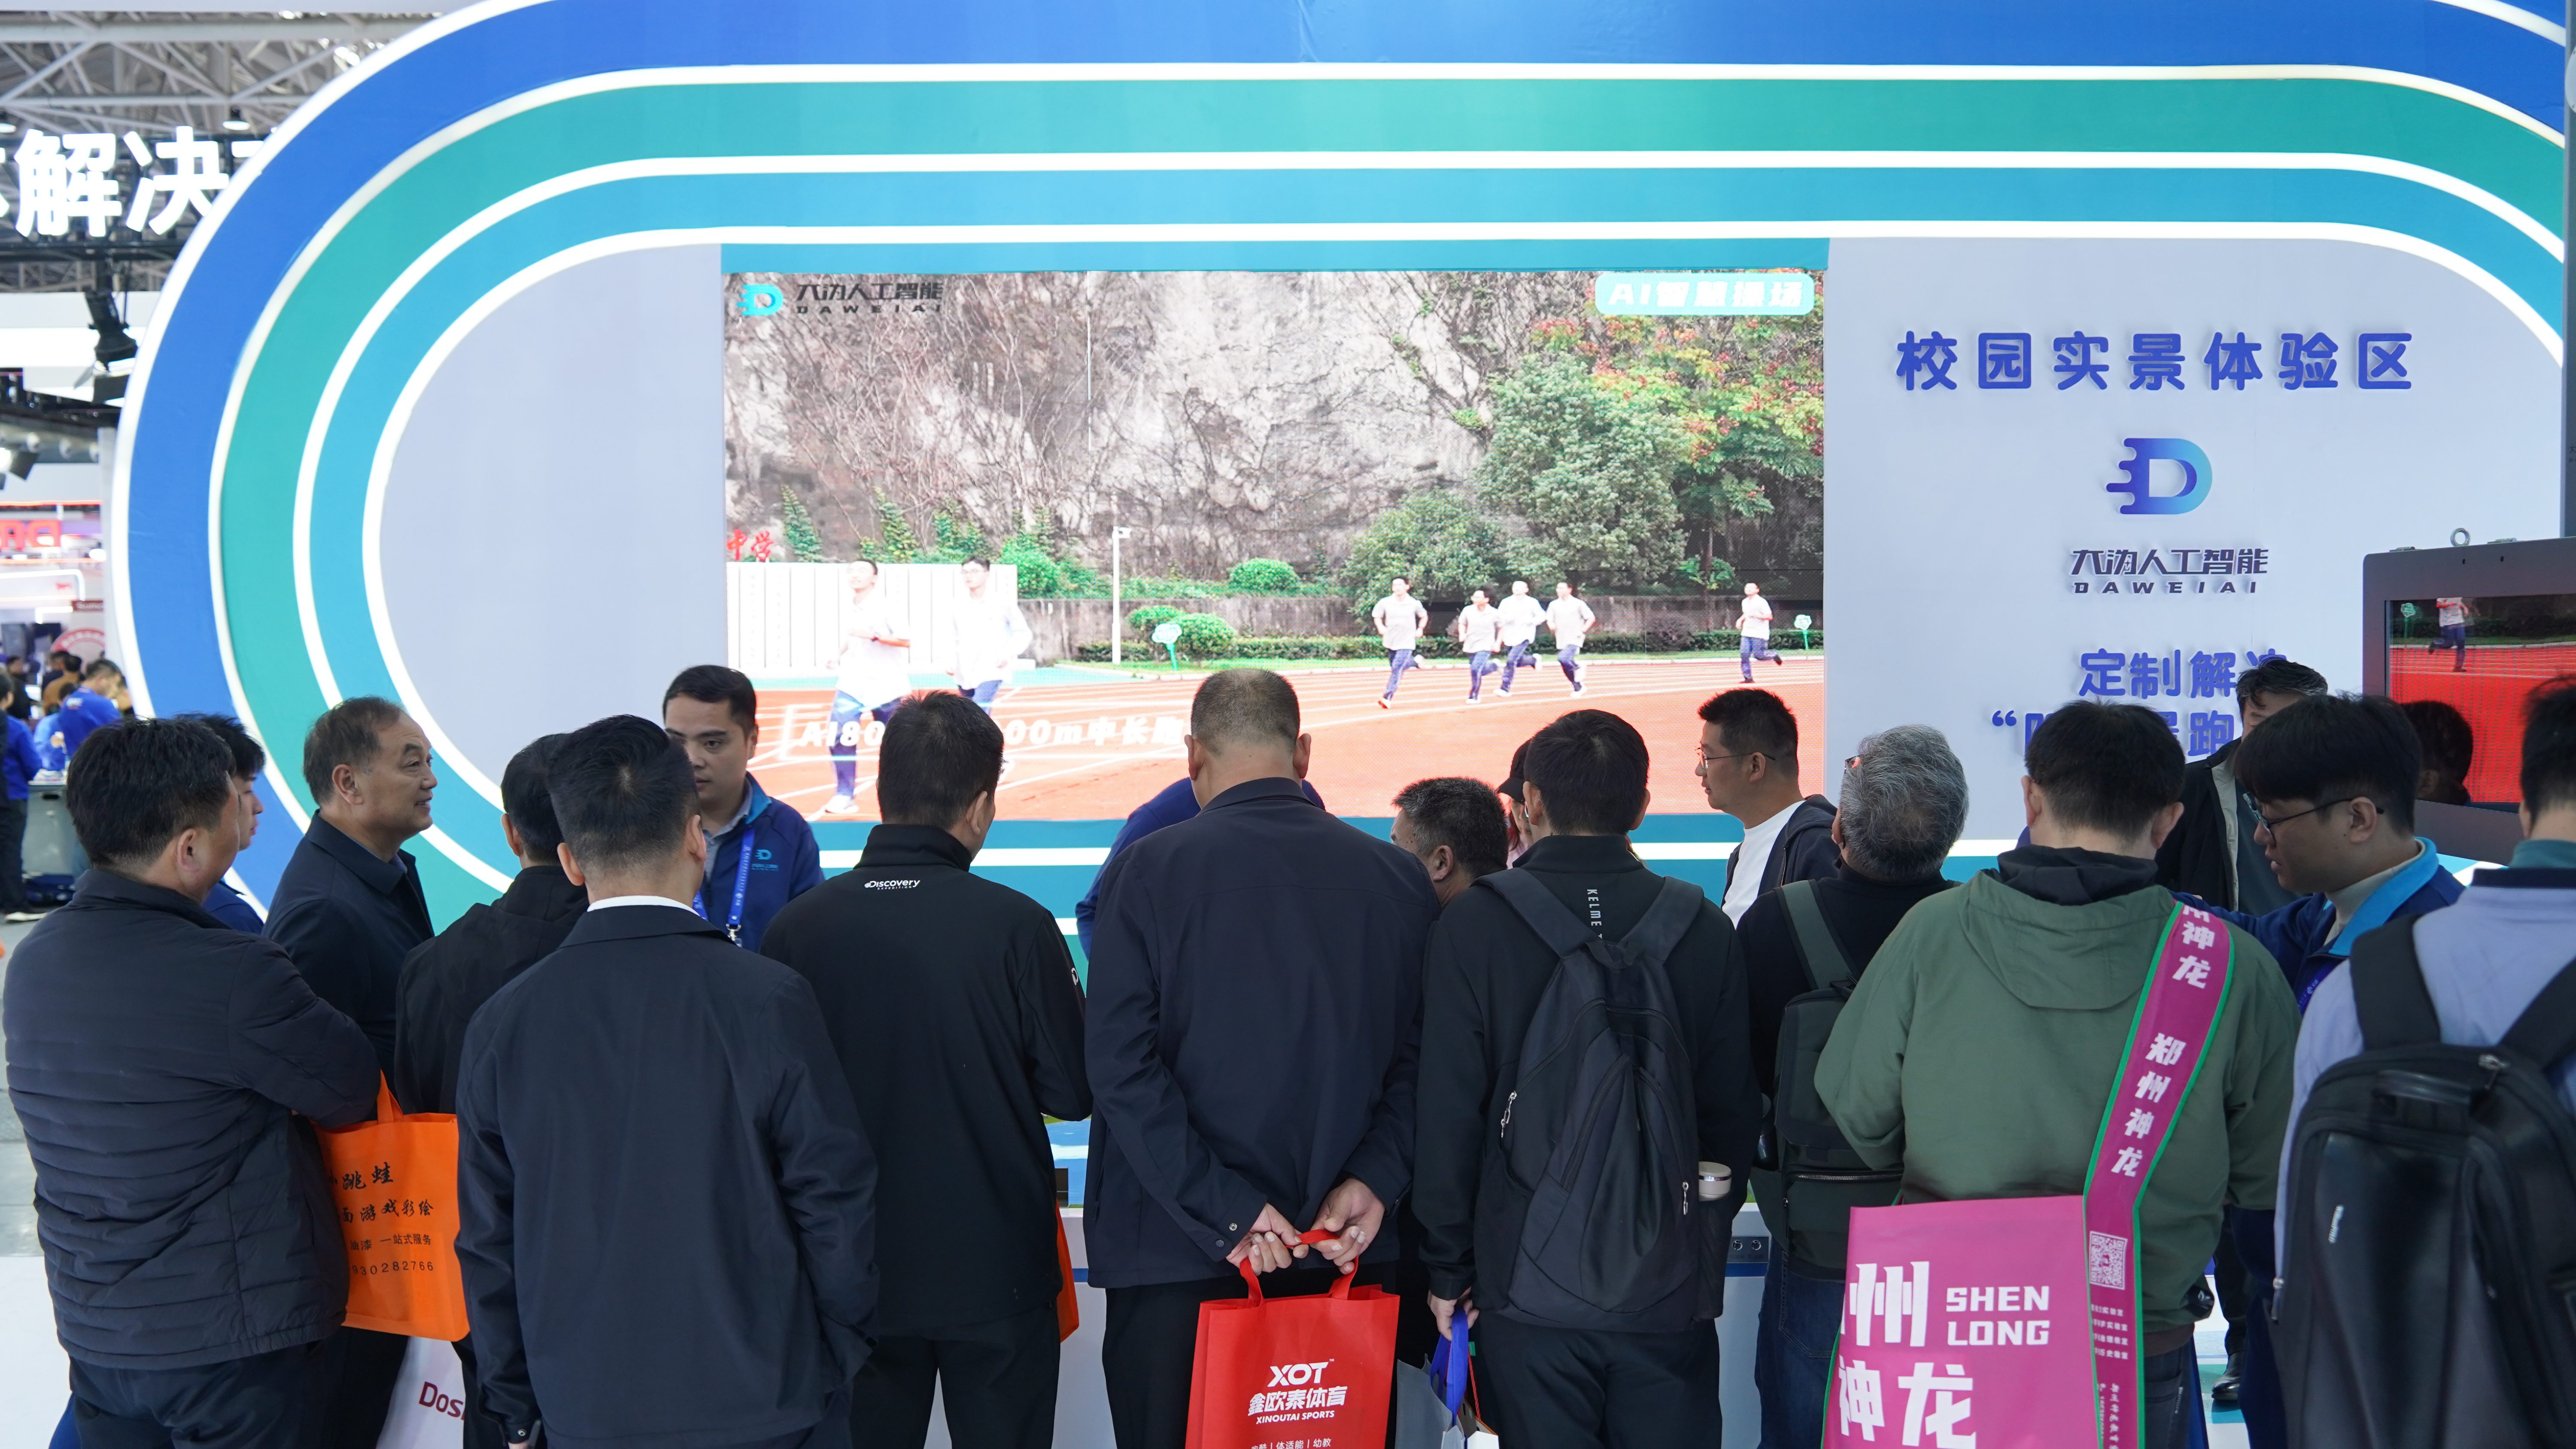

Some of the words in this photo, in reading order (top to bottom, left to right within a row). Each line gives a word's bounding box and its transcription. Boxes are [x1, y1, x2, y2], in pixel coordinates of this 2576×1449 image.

[0, 126, 265, 237] 解决
[796, 305, 942, 314] DAWEIAI
[1896, 330, 2412, 391] 校园实景体验区
[2074, 582, 2256, 594] DAWEIAI
[869, 879, 920, 888] Discovery
[1587, 889, 1602, 926] KELME
[2111, 1032, 2187, 1178] 郑州神龙
[380, 1234, 431, 1245] 一站式服务
[1841, 1261, 1930, 1347] 州
[1946, 1285, 2050, 1312] SHEN
[1947, 1320, 2050, 1346] LONG
[1267, 1361, 1329, 1387] XOT
[1248, 1386, 1348, 1416] 鑫欧泰体育
[1838, 1355, 1977, 1449] 神龙
[1256, 1413, 1300, 1425] XINOUTAI
[1301, 1410, 1335, 1420] SPORTS
[1313, 1438, 1332, 1448] 幼教
